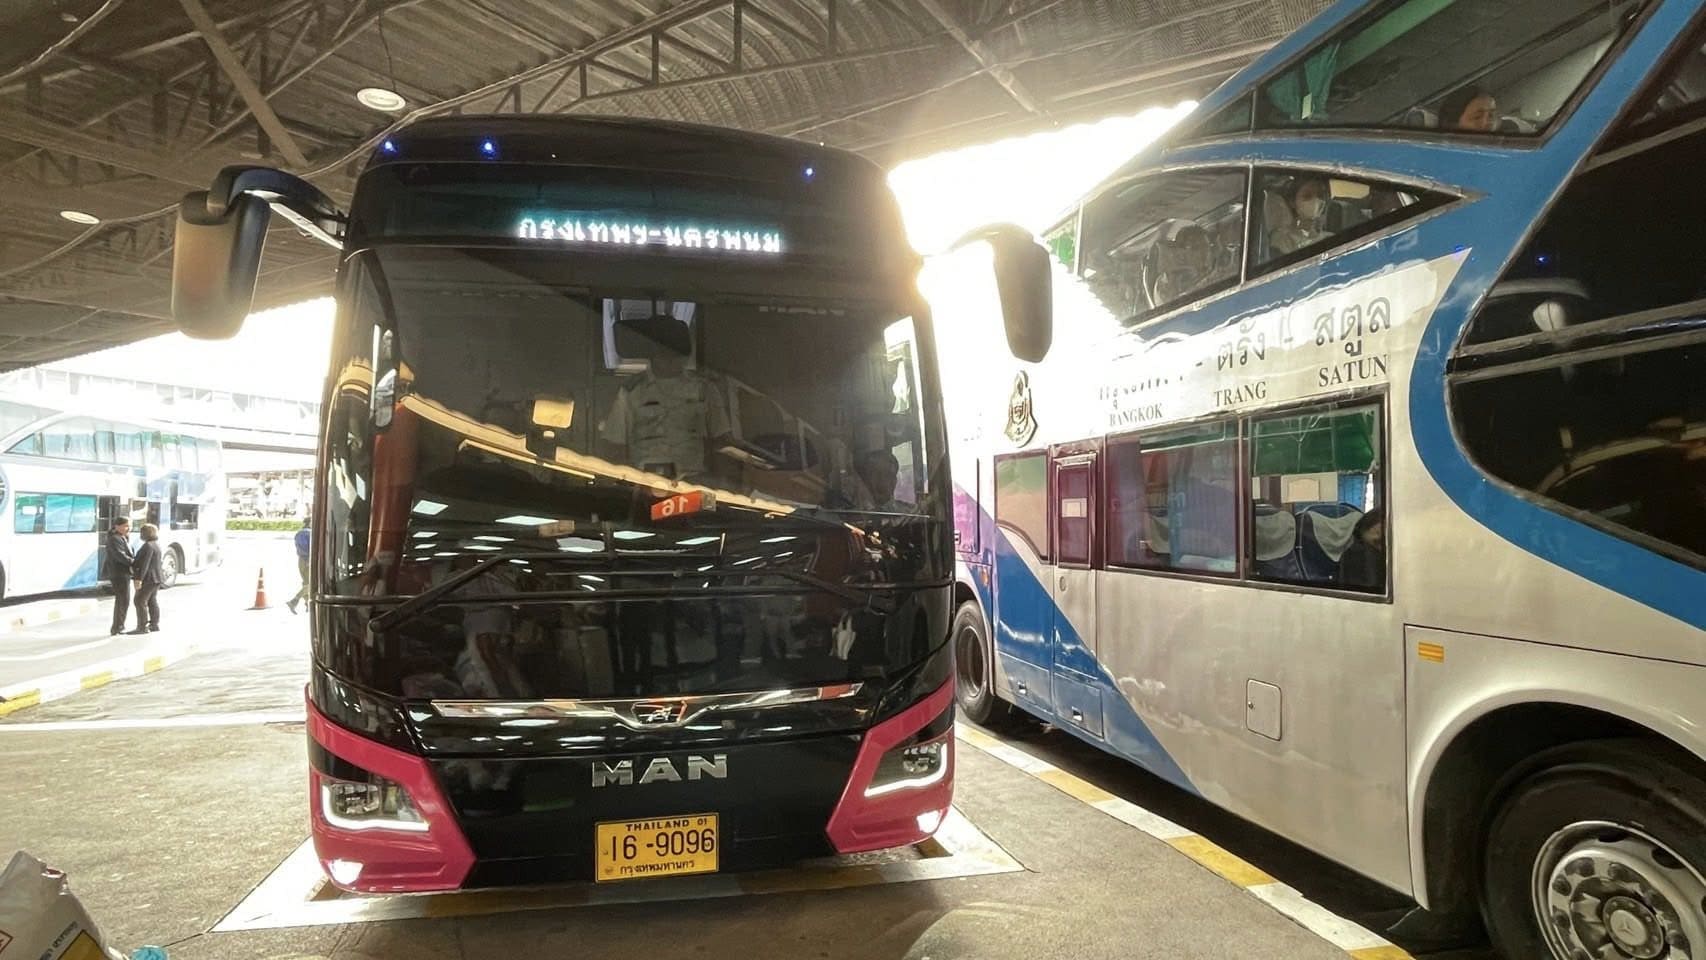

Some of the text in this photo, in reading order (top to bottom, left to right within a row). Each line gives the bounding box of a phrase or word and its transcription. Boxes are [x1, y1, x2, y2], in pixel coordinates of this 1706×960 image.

[519, 217, 780, 252] กรงเทพฯ-นครพนม
[1314, 298, 1391, 357] สตูล
[1213, 382, 1266, 407] TRANG
[1318, 355, 1389, 387] SATUN
[592, 754, 728, 788] MAN
[626, 818, 707, 832] THAILAND 01
[620, 861, 695, 877] กรุงเทพมหานคร
